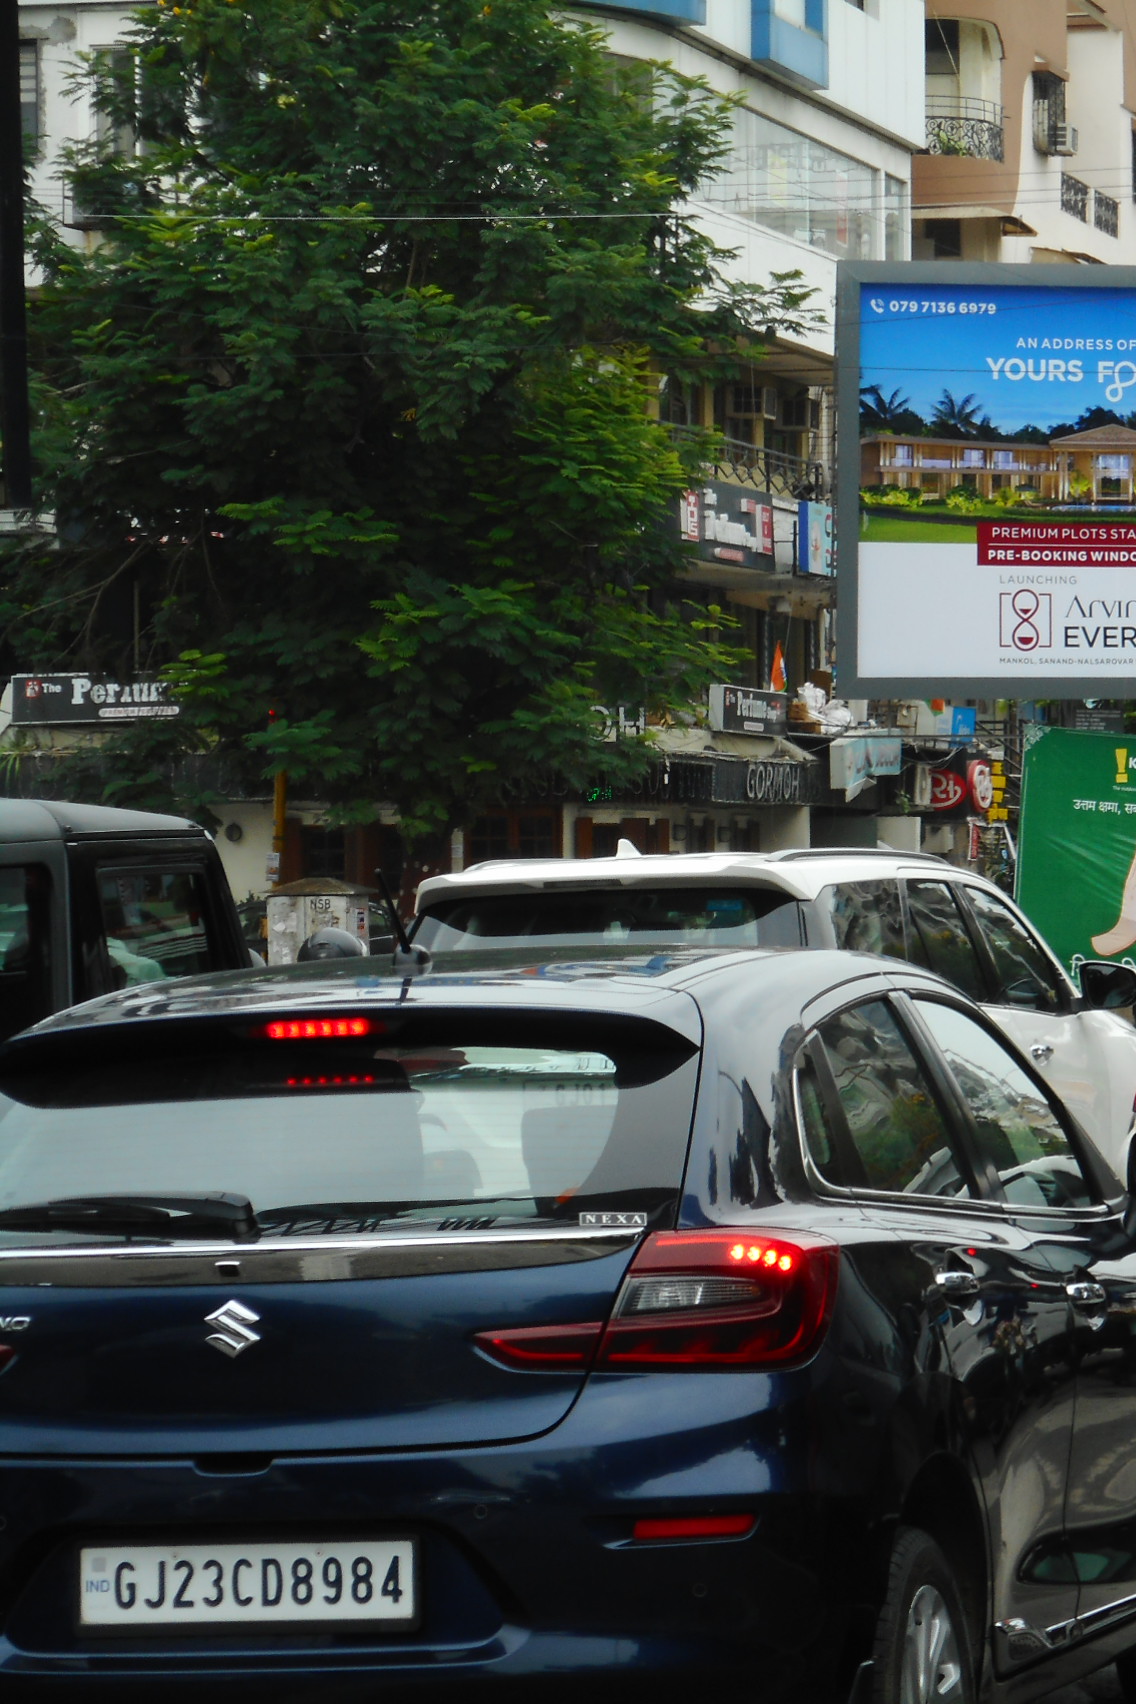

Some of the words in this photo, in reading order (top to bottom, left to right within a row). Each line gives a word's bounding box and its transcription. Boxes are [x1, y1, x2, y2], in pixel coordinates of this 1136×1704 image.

[889, 300, 918, 312] 079
[921, 301, 956, 313] 7136
[958, 302, 997, 314] 6979
[1016, 337, 1038, 348] AN
[1041, 338, 1113, 350] ADDRESS
[1116, 339, 1136, 350] OF
[986, 357, 1084, 382] YOURS
[991, 527, 1059, 539] PREMIUM
[1061, 528, 1107, 539] PLOTS
[988, 550, 1088, 561] PRE-BOOKING
[999, 575, 1078, 585] LAUNCHING
[310, 898, 331, 910] NSB
[585, 1214, 642, 1224] NEXA
[85, 1580, 109, 1593] IND
[114, 1555, 403, 1610] GJ23CD8984
